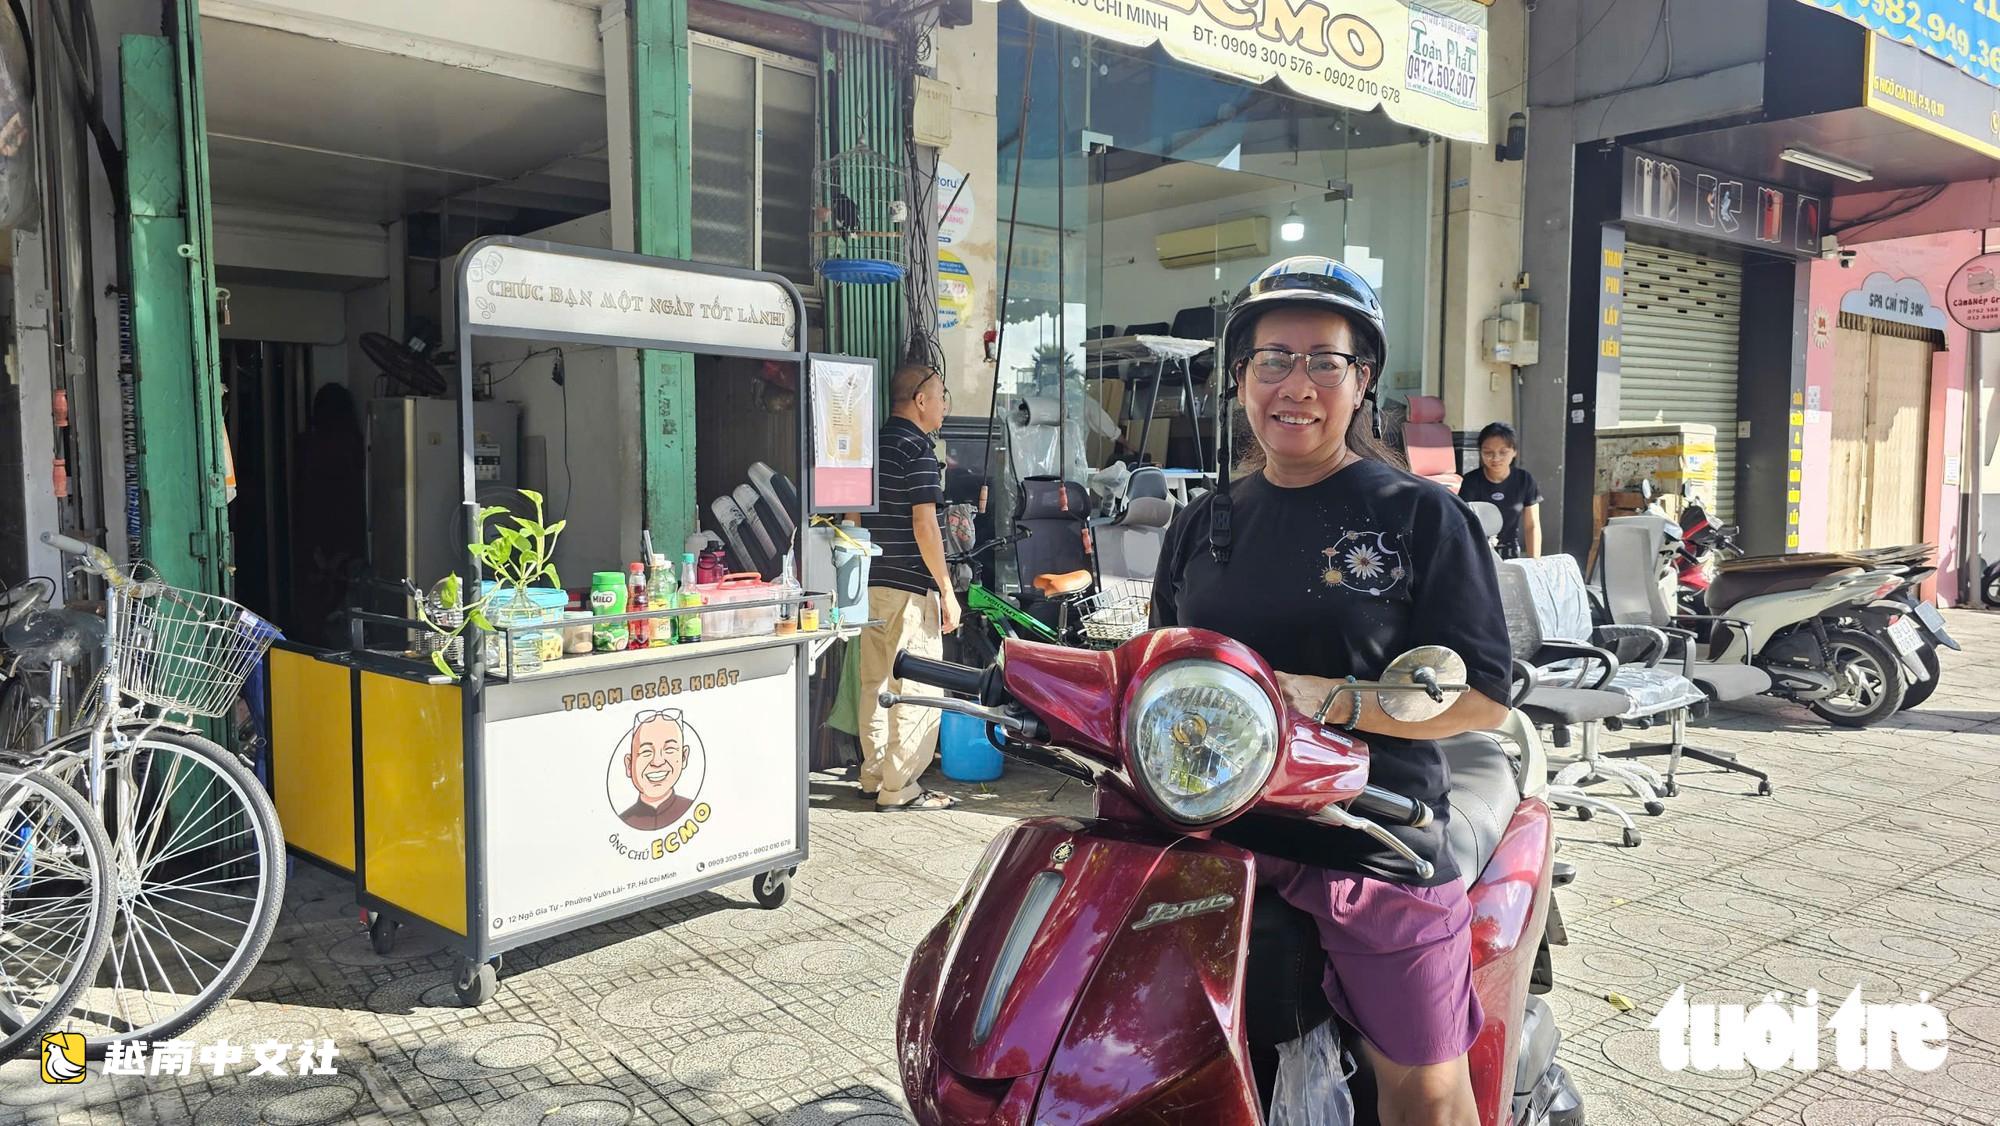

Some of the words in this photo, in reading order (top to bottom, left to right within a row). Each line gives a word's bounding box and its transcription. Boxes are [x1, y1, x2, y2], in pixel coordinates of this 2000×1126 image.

[1127, 3, 1169, 32] MINH
[1193, 24, 1218, 48] ĐT:
[1221, 34, 1258, 59] 0909
[1261, 46, 1287, 69] 300
[1290, 56, 1313, 77] 576
[1324, 66, 1354, 91] 0902
[1357, 77, 1378, 97] 010
[1381, 84, 1401, 105] 678
[1407, 54, 1476, 99] 0972.502.907
[487, 273, 544, 302] CHÚC
[549, 286, 593, 308] BẠN
[600, 289, 644, 313] MỘT
[649, 294, 694, 317] NGÀY
[700, 294, 734, 321] TỐT
[1869, 293, 1883, 309] SPA
[592, 595, 613, 603] MILO
[562, 687, 623, 711] TRẠM
[631, 675, 682, 701] GIẢI
[608, 832, 628, 855] ÔNG
[651, 802, 712, 860] ECMO
[508, 916, 517, 924] 12
[535, 907, 548, 917] Gia
[661, 871, 677, 881] Minh
